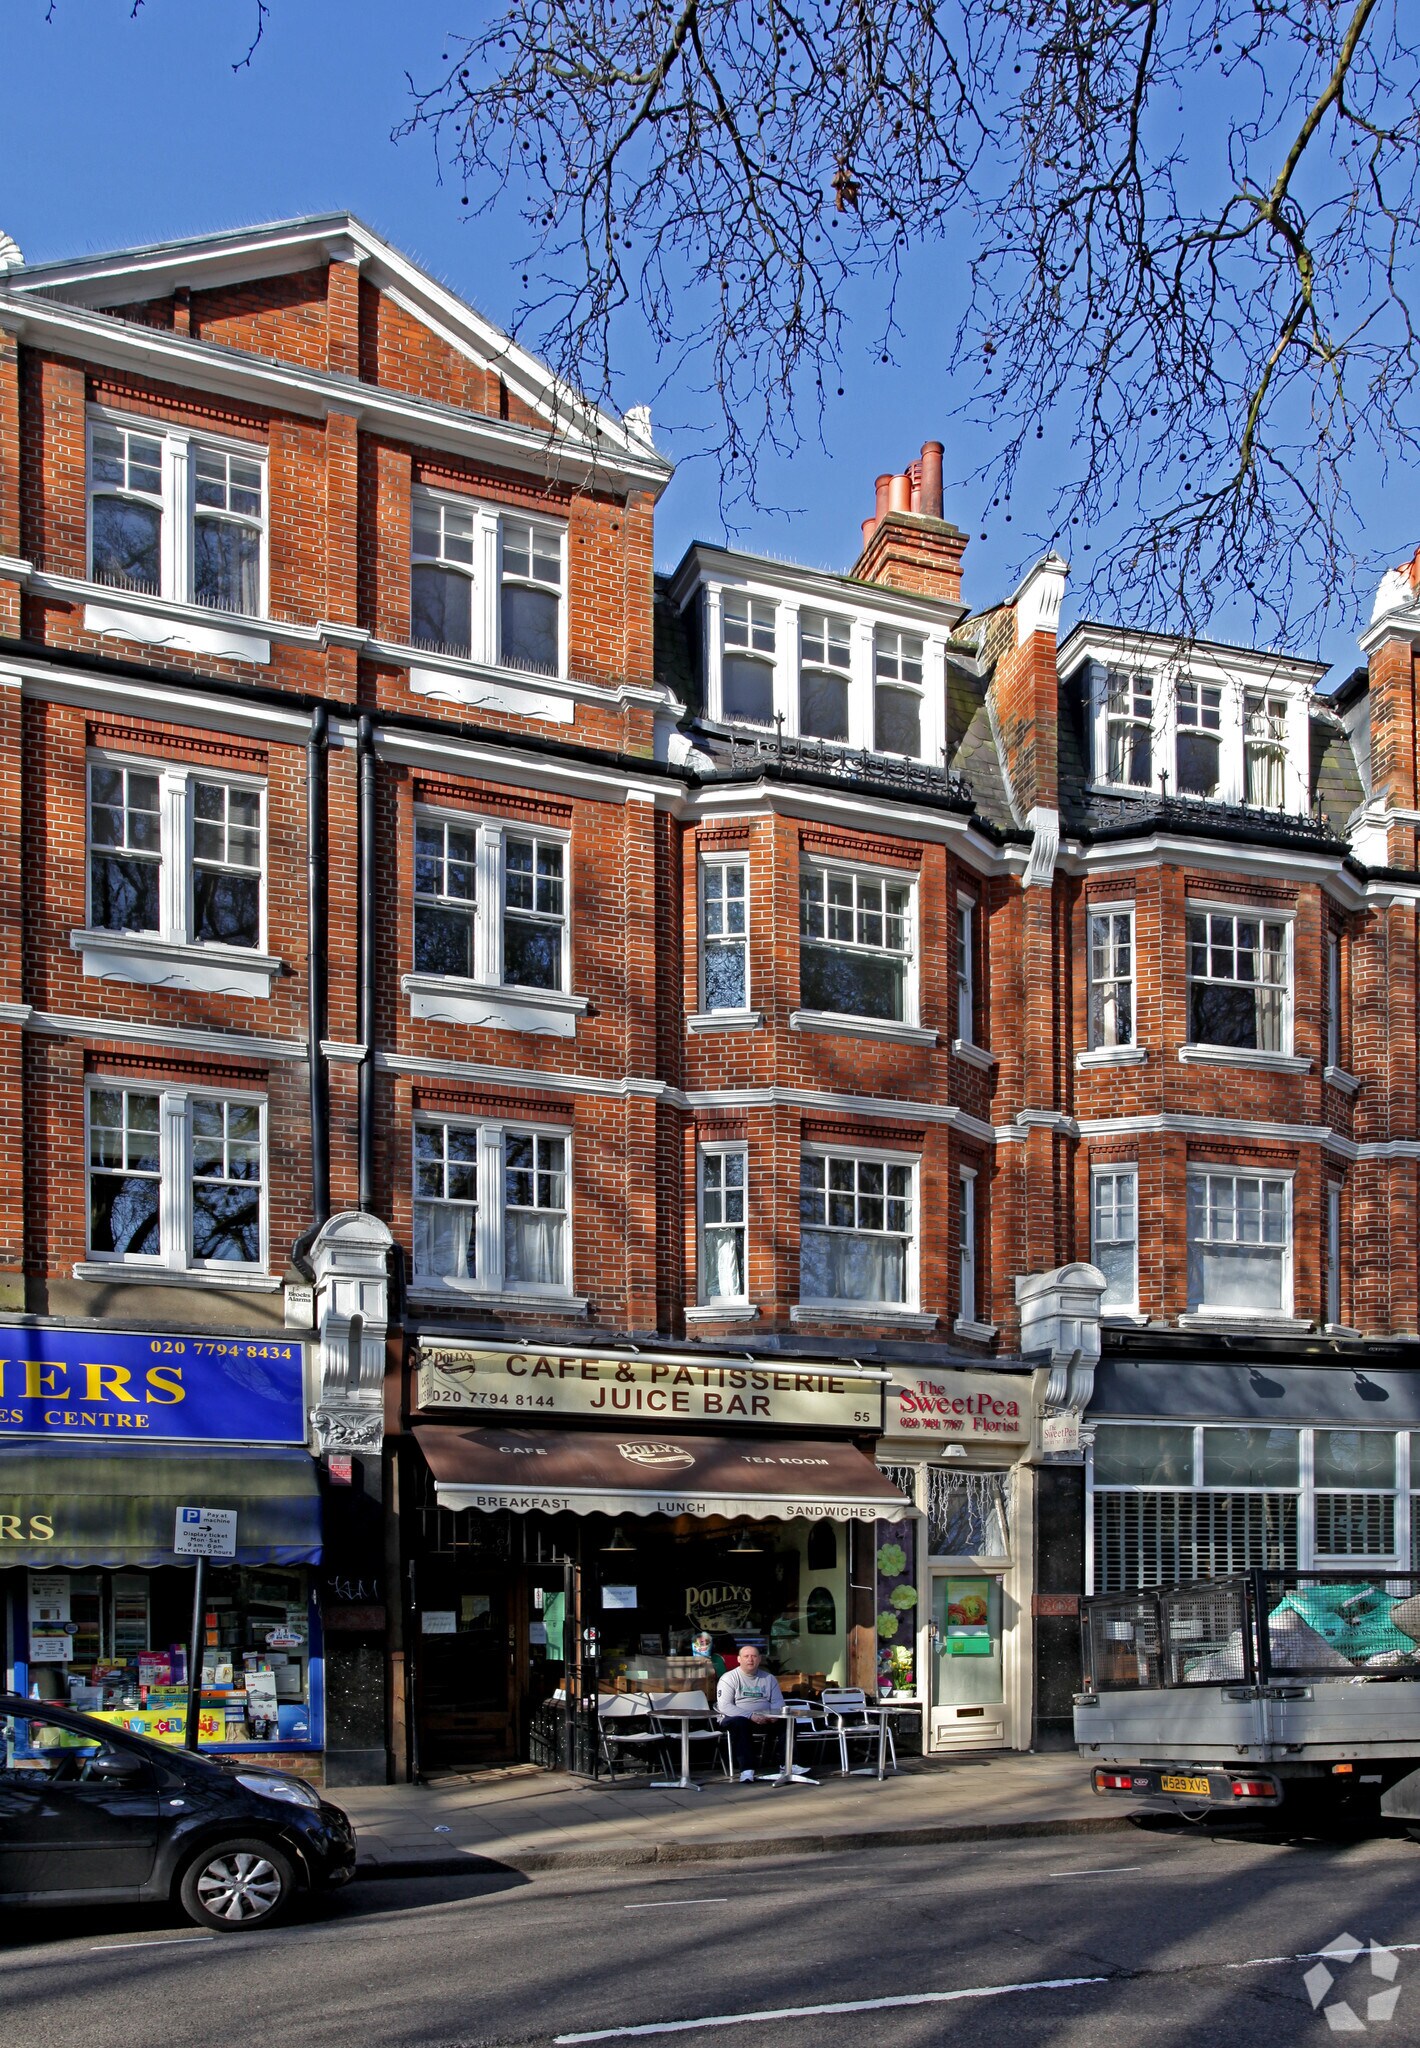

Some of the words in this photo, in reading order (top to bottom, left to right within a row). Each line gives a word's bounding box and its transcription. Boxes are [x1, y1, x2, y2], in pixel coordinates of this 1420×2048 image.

[150, 1340, 186, 1354] 020
[193, 1342, 239, 1357] 7794
[246, 1345, 292, 1360] 8434
[505, 1353, 600, 1381] CAFE
[614, 1361, 637, 1383] &
[650, 1363, 846, 1394] PATISSERIE
[0, 1359, 187, 1405] ERS
[916, 1380, 946, 1396] The
[433, 1390, 462, 1402] 020
[468, 1392, 509, 1405] 7794
[515, 1394, 555, 1408] 8144
[590, 1387, 691, 1413] JUICE
[703, 1392, 772, 1416] BAR
[44, 1410, 150, 1429] CENTRE
[854, 1411, 870, 1423] 55
[972, 1416, 1020, 1433] Florist
[498, 1446, 548, 1455] CAFE
[741, 1456, 777, 1464] TEA
[779, 1457, 829, 1465] ROOM
[476, 1496, 570, 1510] BREAKFAST
[657, 1502, 706, 1514] LUNCH
[786, 1504, 876, 1518] SANDWICHES
[0, 1515, 55, 1540] RS
[1162, 1777, 1187, 1790] W529
[1189, 1779, 1208, 1792] XVS
